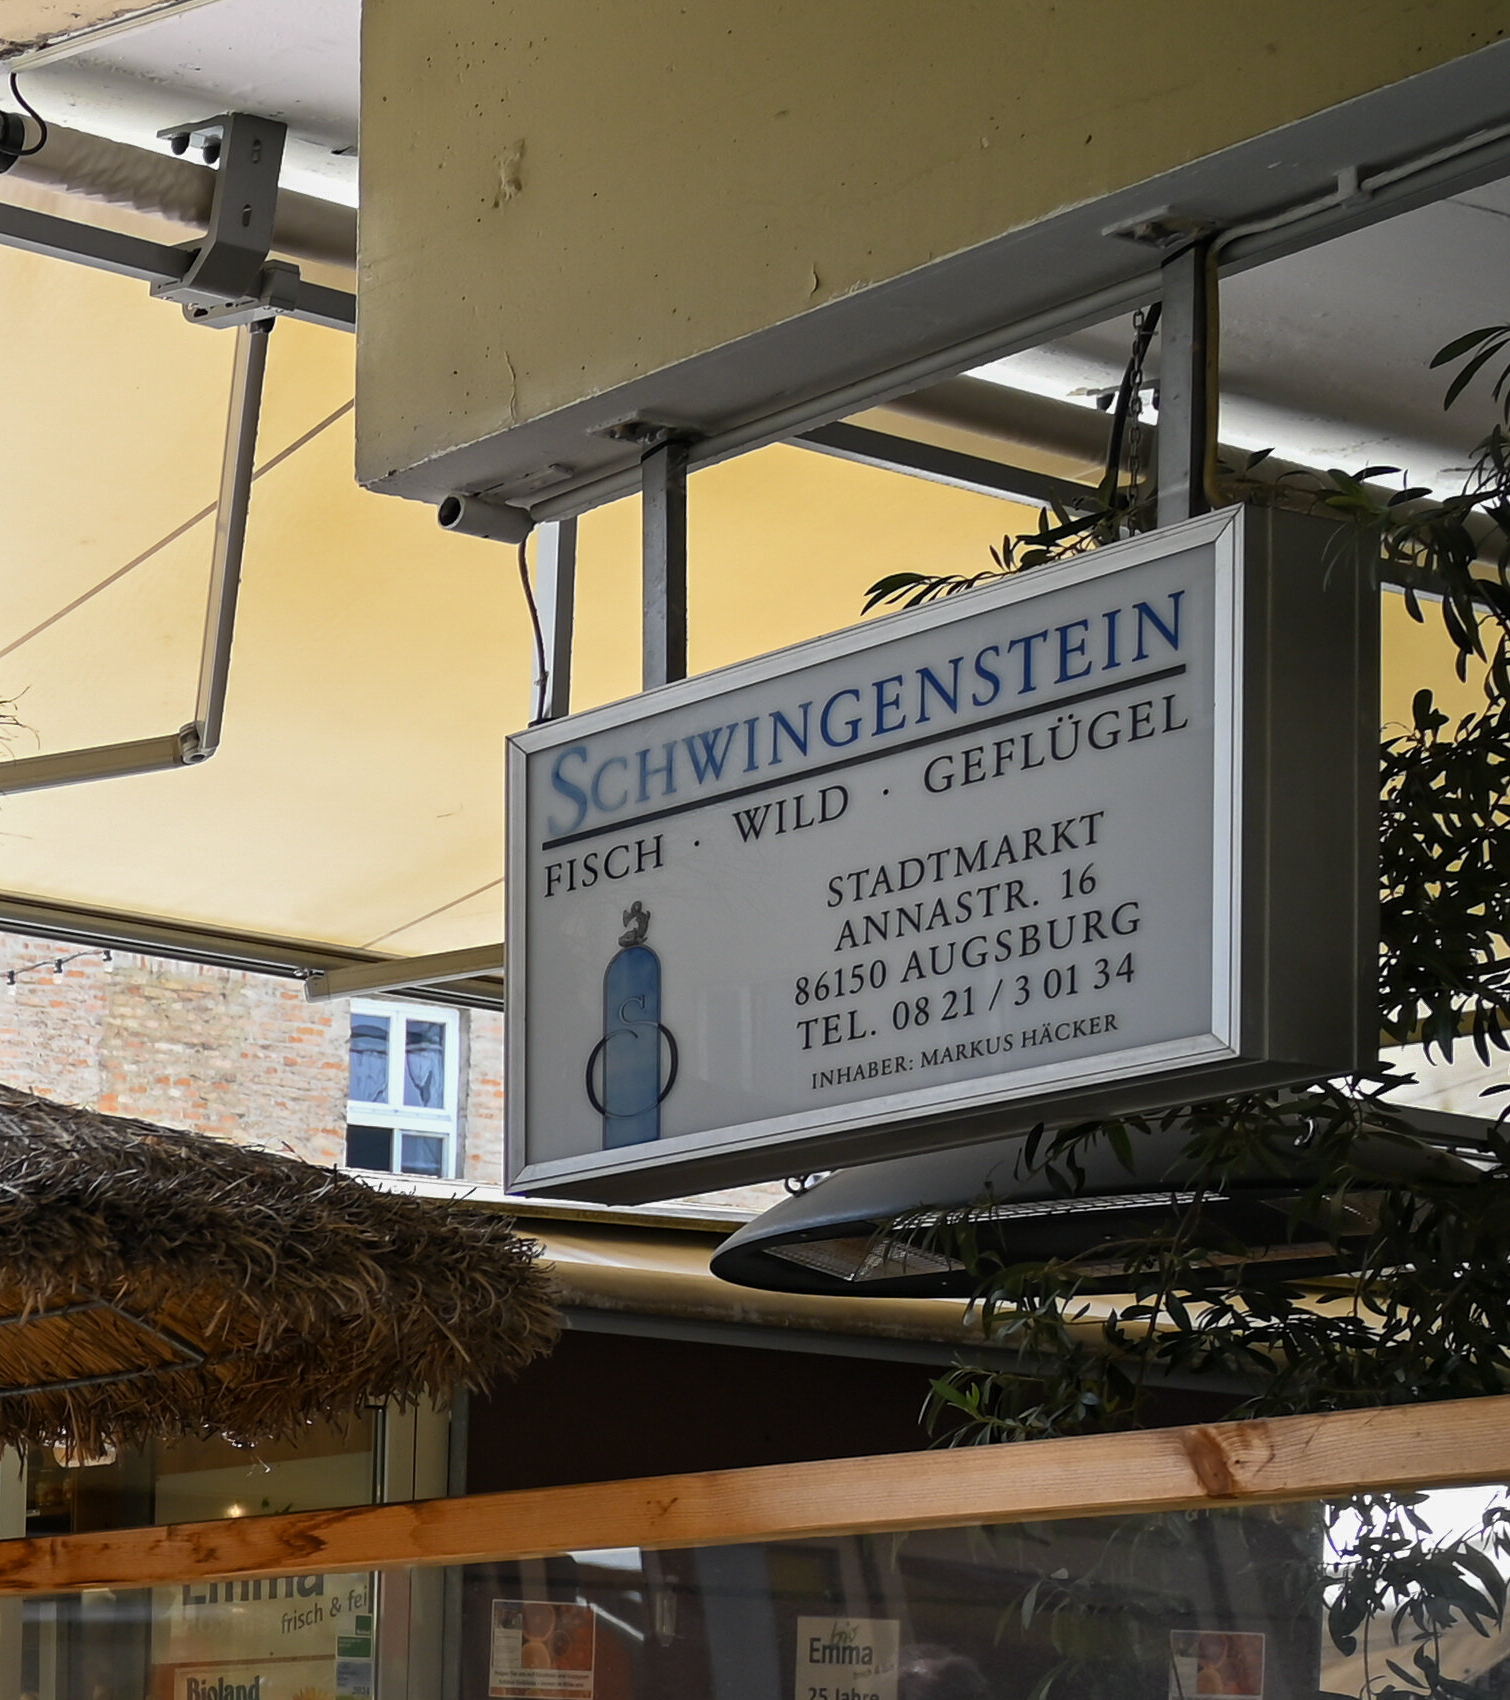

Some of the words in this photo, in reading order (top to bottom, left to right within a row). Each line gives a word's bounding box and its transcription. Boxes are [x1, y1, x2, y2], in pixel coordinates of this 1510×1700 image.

[543, 834, 664, 898] FISCH
[733, 784, 849, 842] WILD
[923, 694, 1188, 794] GEFLÜGEL
[827, 810, 1105, 908] STADTMARKT
[834, 879, 1040, 952] ANNASTR.
[1061, 862, 1098, 900] 16
[794, 959, 888, 1006] 86150
[900, 901, 1142, 983] AUGSBURG
[796, 1009, 877, 1051] TEL.
[811, 1055, 914, 1090] INHABER:
[920, 1034, 1014, 1069] MARKUS
[1020, 1013, 1119, 1049] HÄCKER
[281, 1603, 324, 1634] frisch
[329, 1596, 342, 1618] &
[348, 1585, 369, 1612] fei
[809, 1636, 874, 1665] Emma
